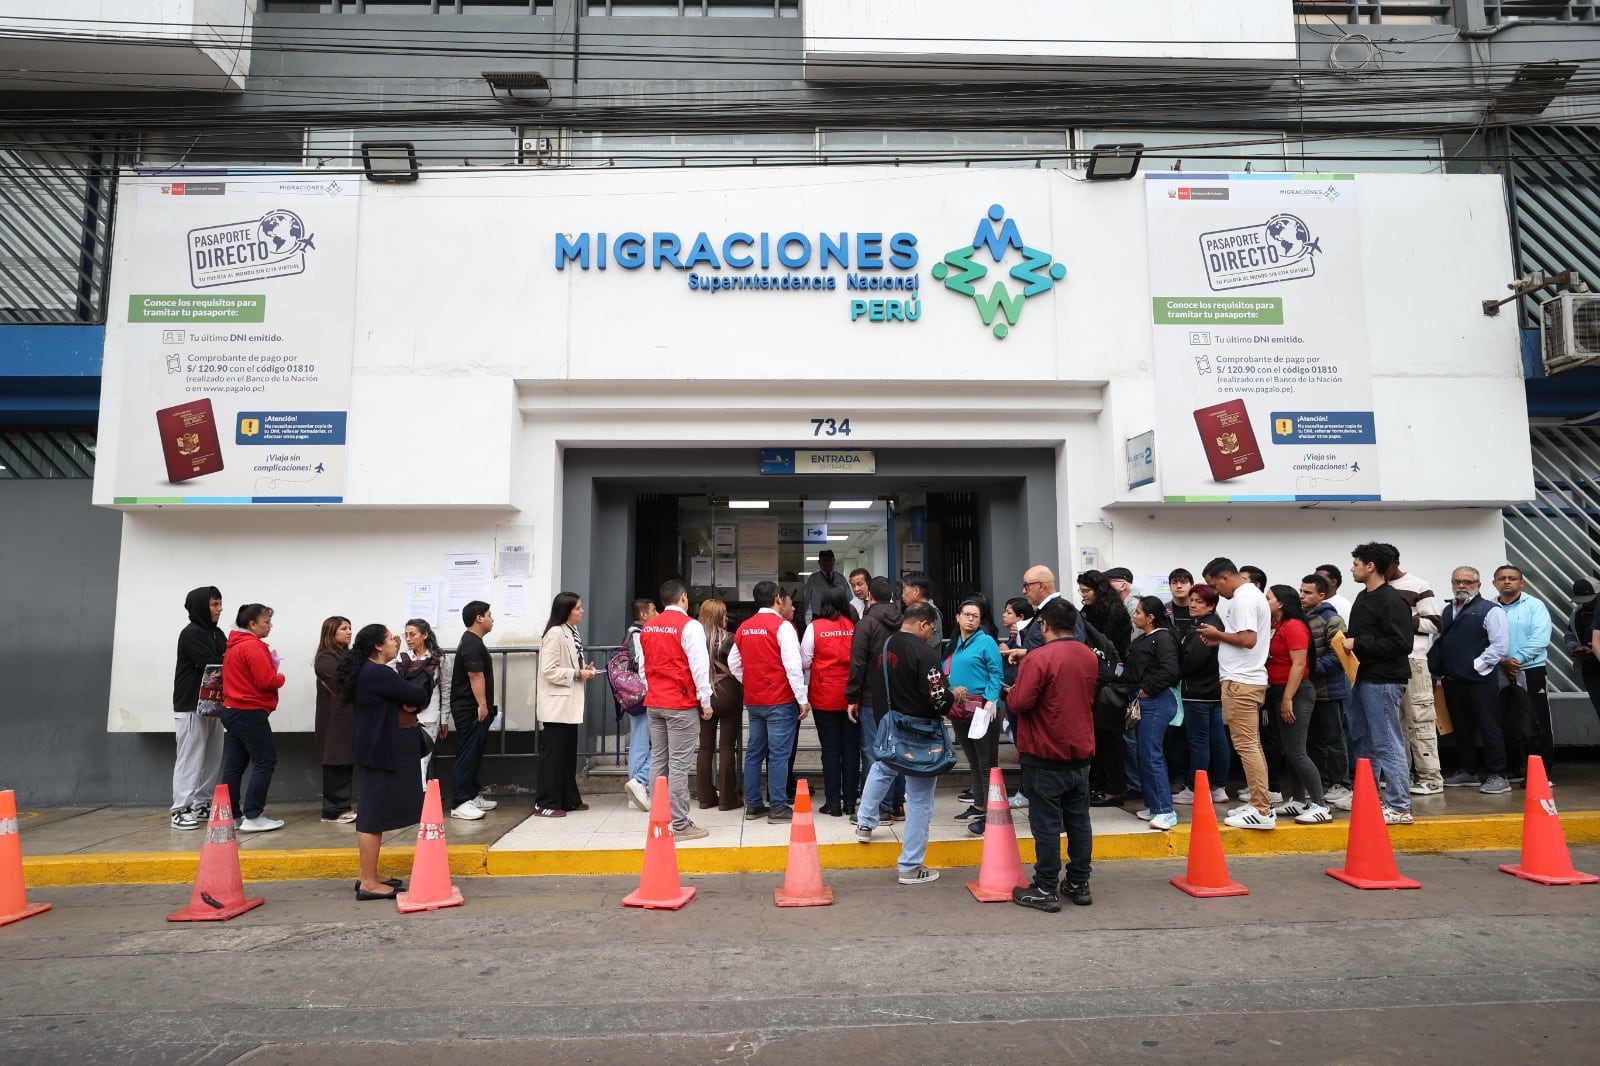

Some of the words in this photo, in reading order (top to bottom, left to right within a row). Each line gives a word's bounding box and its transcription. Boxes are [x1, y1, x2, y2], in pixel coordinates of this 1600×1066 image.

[194, 229, 252, 248] PASAPORTE
[1207, 233, 1260, 251] PASAPORTE
[196, 241, 269, 270] DIRECTO
[555, 232, 919, 270] MIGRACIONES
[1209, 245, 1279, 272] DIRECTO
[688, 272, 835, 291] Superintendencia
[847, 272, 920, 291] Nacional
[144, 299, 176, 307] Conoce
[178, 299, 190, 307] los
[192, 299, 235, 309] requisitos
[237, 301, 256, 309] para
[850, 291, 922, 322] PERÚ
[1167, 301, 1198, 309] Conoce
[1200, 301, 1212, 309] los
[1213, 301, 1254, 311] requisitos
[1256, 303, 1274, 311] para
[192, 309, 238, 318] pasaporte:
[1168, 310, 1202, 318] tramitar
[1214, 311, 1258, 320] pasaporte:
[190, 334, 199, 342] Tu
[202, 333, 228, 342] último
[230, 334, 246, 342] DNI
[249, 334, 284, 342] emitido.
[1226, 335, 1252, 343] último
[1272, 335, 1304, 343] emitido.
[188, 354, 246, 363] Comprobante
[248, 354, 259, 362] de
[261, 356, 280, 364] pago
[283, 356, 298, 364] por
[1216, 355, 1272, 364] Comprobante
[1274, 355, 1284, 363] de
[1286, 357, 1305, 365] pago
[1307, 357, 1320, 365] por
[187, 364, 197, 373] S/
[247, 364, 254, 372] el
[256, 364, 285, 374] código
[1217, 366, 1225, 374] S/
[1283, 366, 1310, 375] código
[186, 375, 224, 383] (realizado
[1218, 376, 1253, 384] (realizado
[811, 418, 851, 436] 734
[266, 454, 288, 462] ¡Viaja
[812, 455, 860, 463] ENTRADA
[1145, 447, 1152, 464] 2
[1303, 453, 1324, 462] ¡Viaja
[253, 464, 312, 473] complicaciones!
[1293, 463, 1348, 471] complicaciones!
